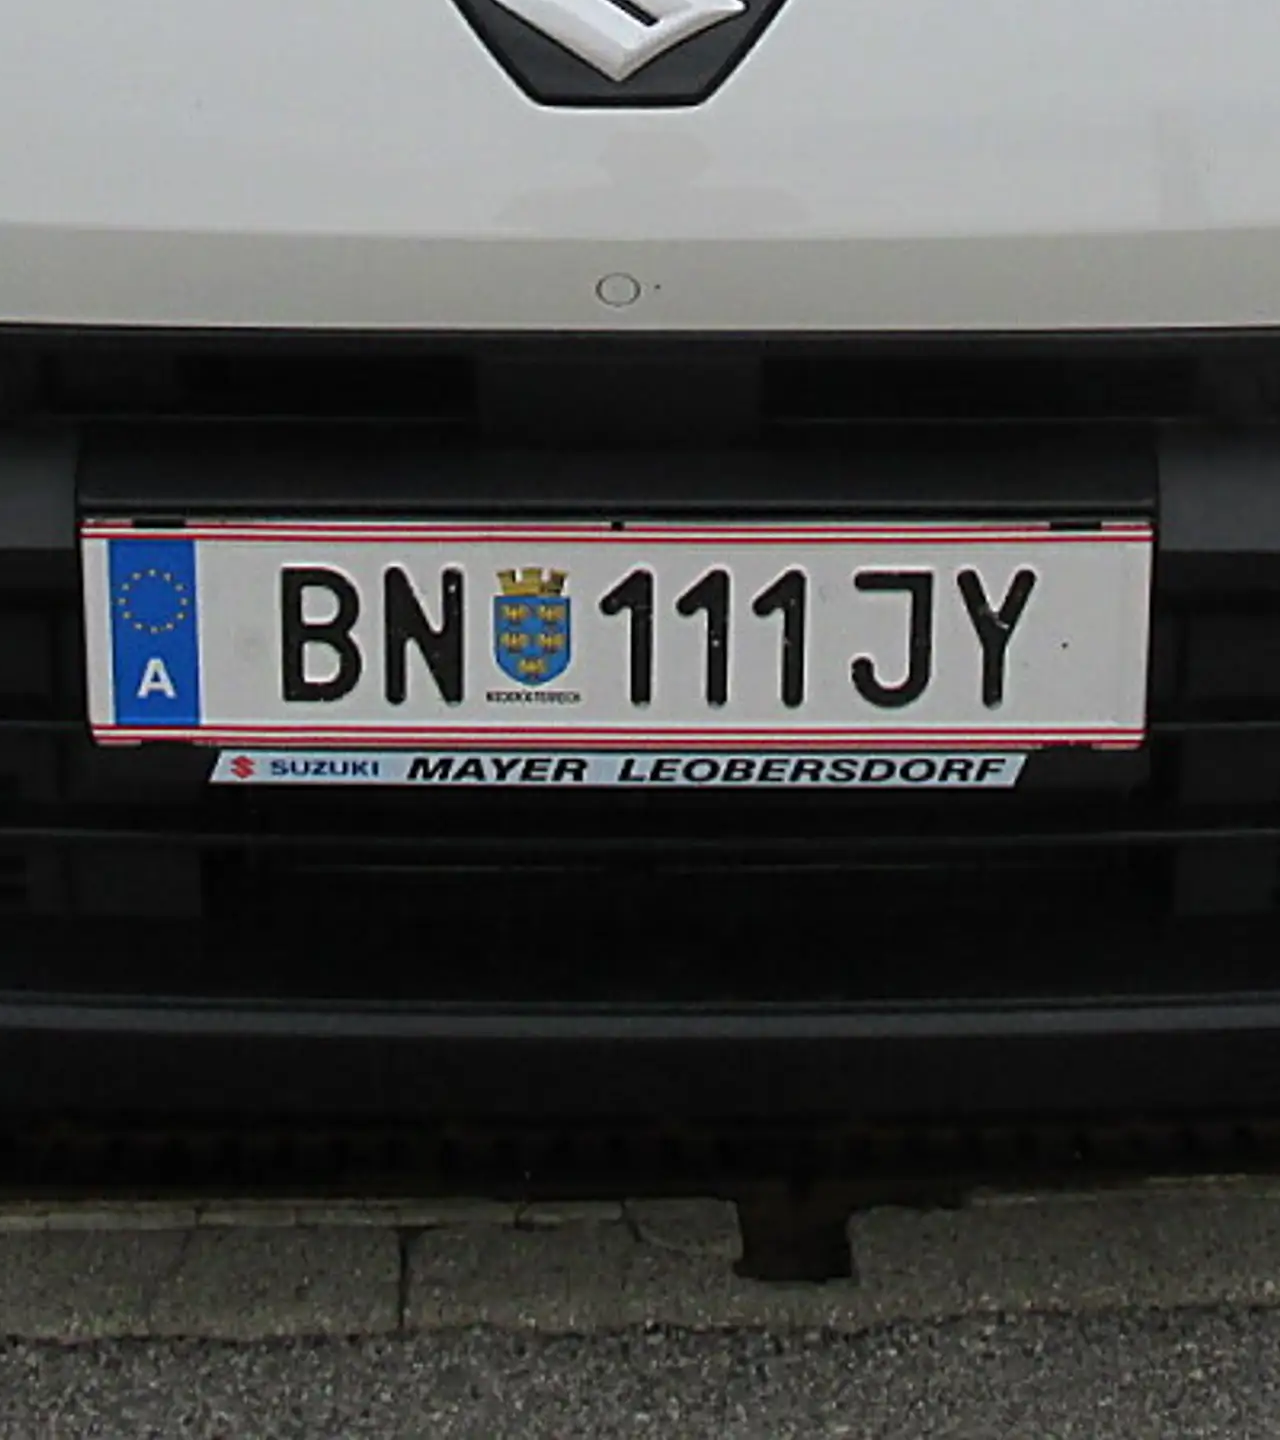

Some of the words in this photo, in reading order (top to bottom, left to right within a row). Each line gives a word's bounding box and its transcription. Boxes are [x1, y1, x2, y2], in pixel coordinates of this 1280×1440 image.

[137, 658, 176, 698] A
[280, 566, 464, 707] BN
[269, 760, 380, 776] SUZUKI
[406, 757, 589, 783] MAYER
[617, 758, 1008, 783] LEOBERSDORF
